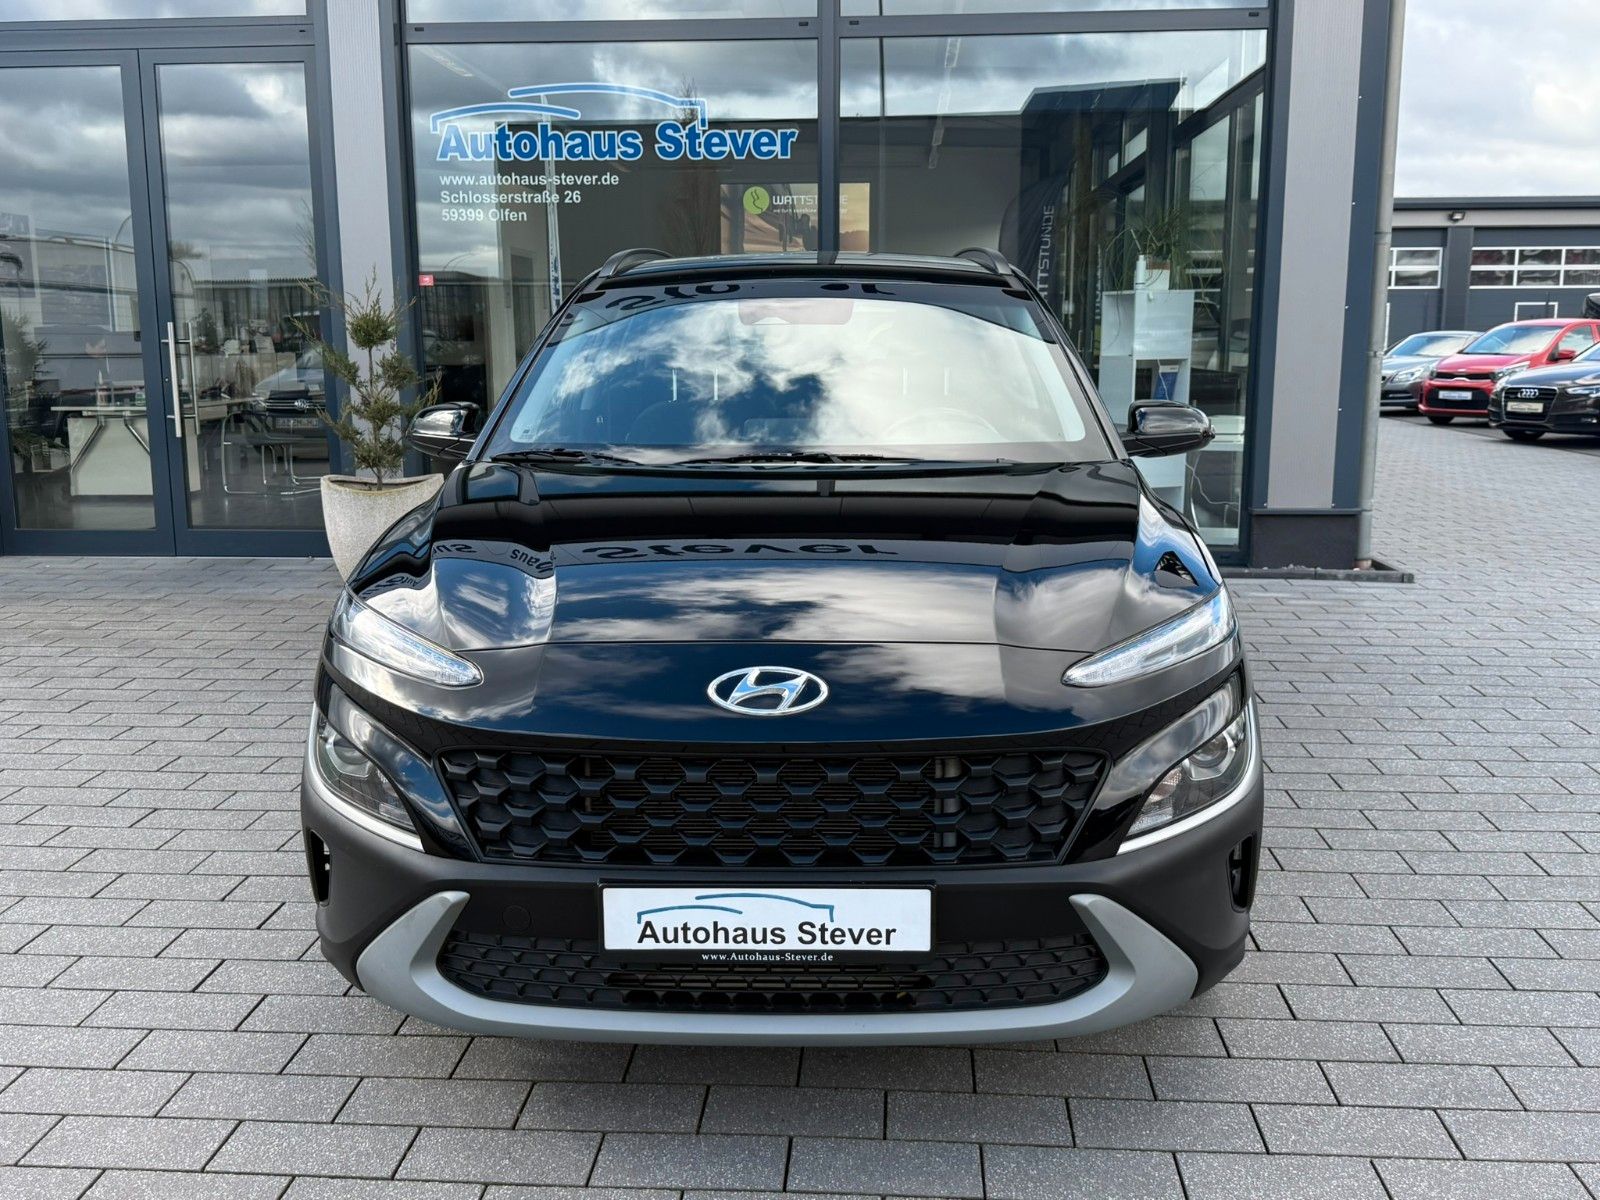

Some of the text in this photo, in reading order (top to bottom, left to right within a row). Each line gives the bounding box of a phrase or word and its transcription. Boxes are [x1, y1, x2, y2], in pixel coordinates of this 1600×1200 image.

[436, 121, 799, 161] Autohaus Stever
[440, 172, 620, 186] www.autohaus-stever.de
[440, 190, 582, 204] Schlosserstraße 26
[441, 208, 528, 222] 59399 Olfen
[637, 920, 897, 946] Autohaus Stever
[701, 952, 835, 962] www.Autohaus-Stever.de
